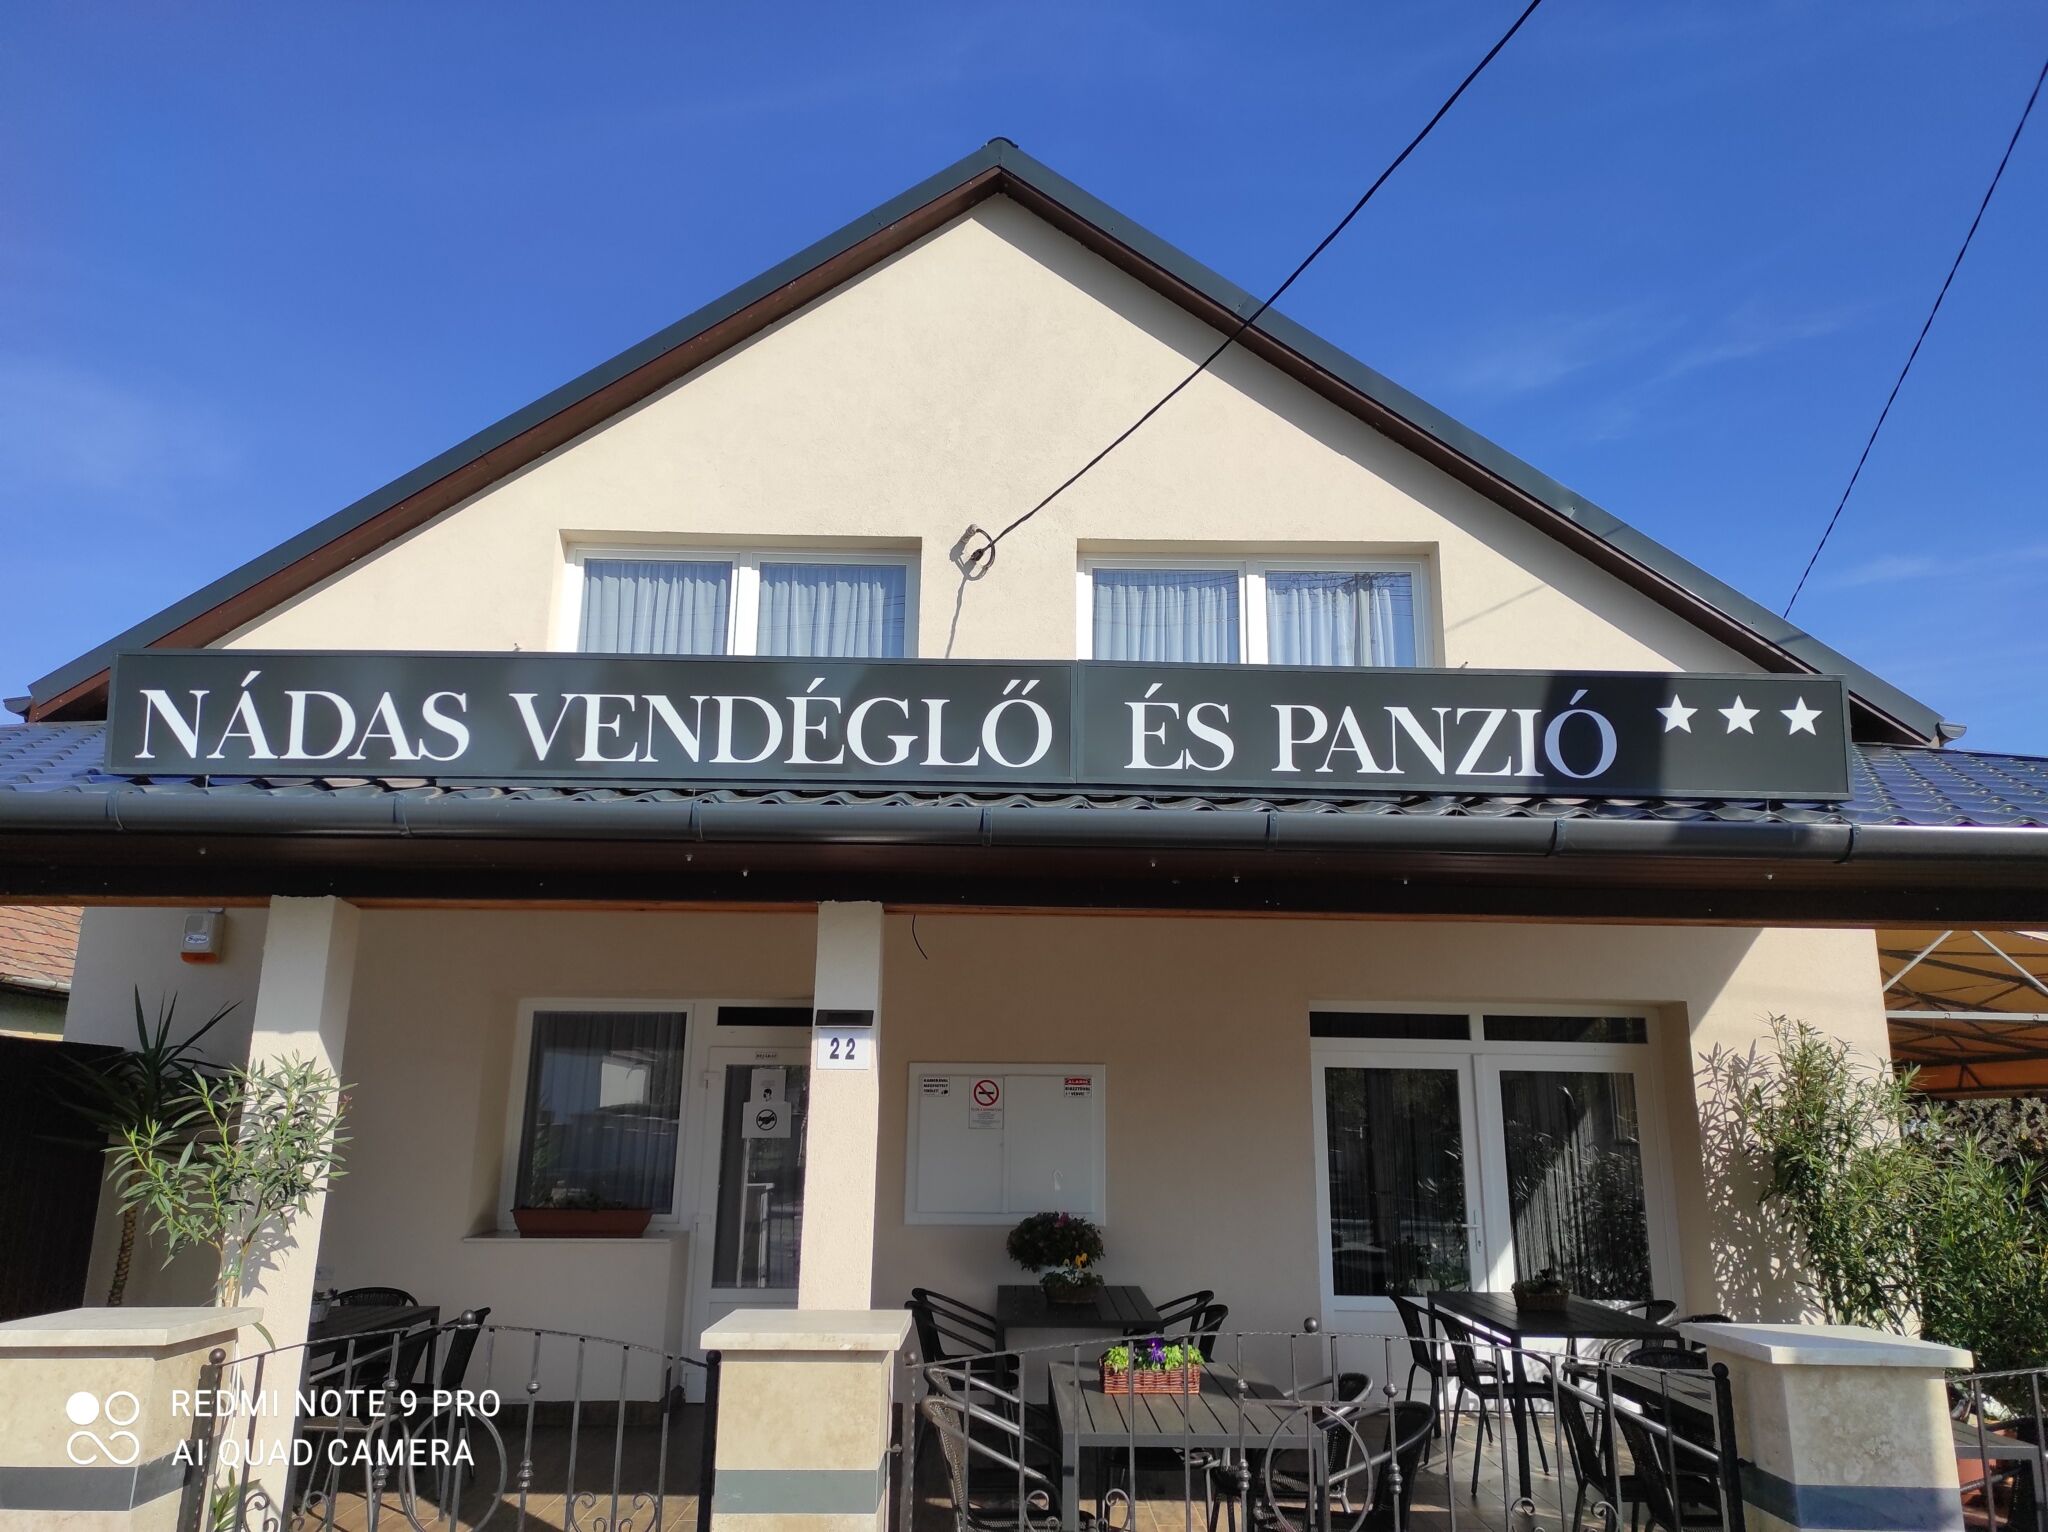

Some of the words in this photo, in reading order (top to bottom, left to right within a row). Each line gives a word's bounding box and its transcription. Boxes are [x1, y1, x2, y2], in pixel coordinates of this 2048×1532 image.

[135, 670, 471, 762] NÁDAS
[509, 677, 1053, 768] VENDÉGLŐ
[1124, 682, 1236, 772] ÉS
[1270, 689, 1618, 779] PANZIÓ
[829, 1037, 856, 1060] 22
